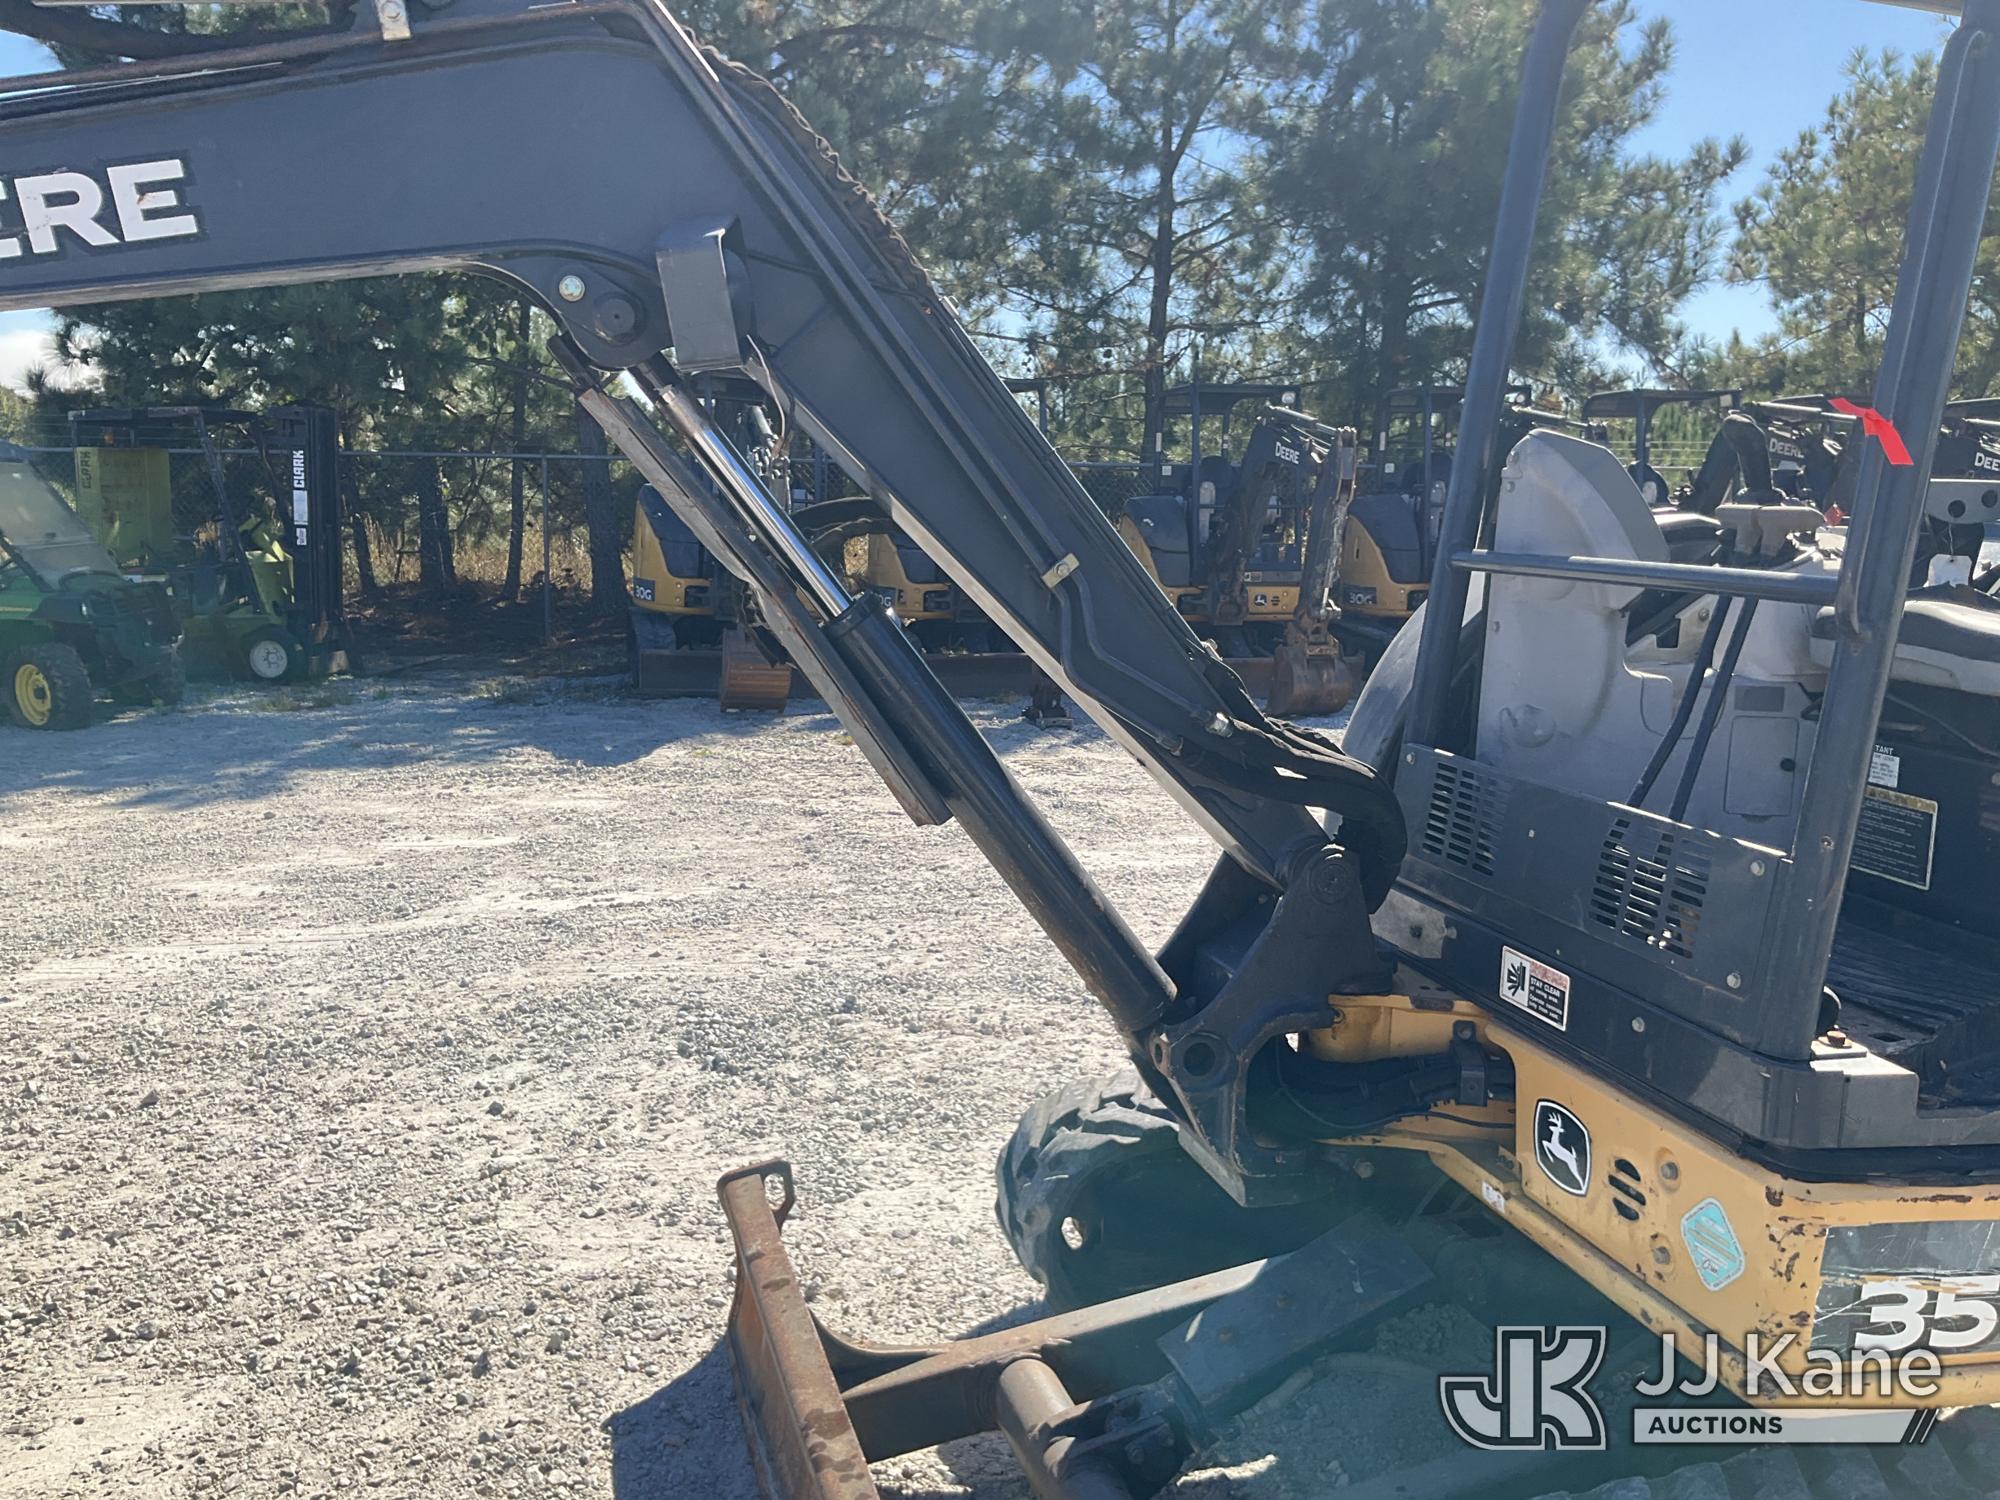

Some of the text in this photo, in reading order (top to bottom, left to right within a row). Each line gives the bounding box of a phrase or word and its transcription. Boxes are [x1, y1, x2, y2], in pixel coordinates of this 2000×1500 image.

[293, 450, 305, 489] CLARK
[1275, 441, 1300, 465] DEERE
[1854, 1275, 2000, 1351] 35
